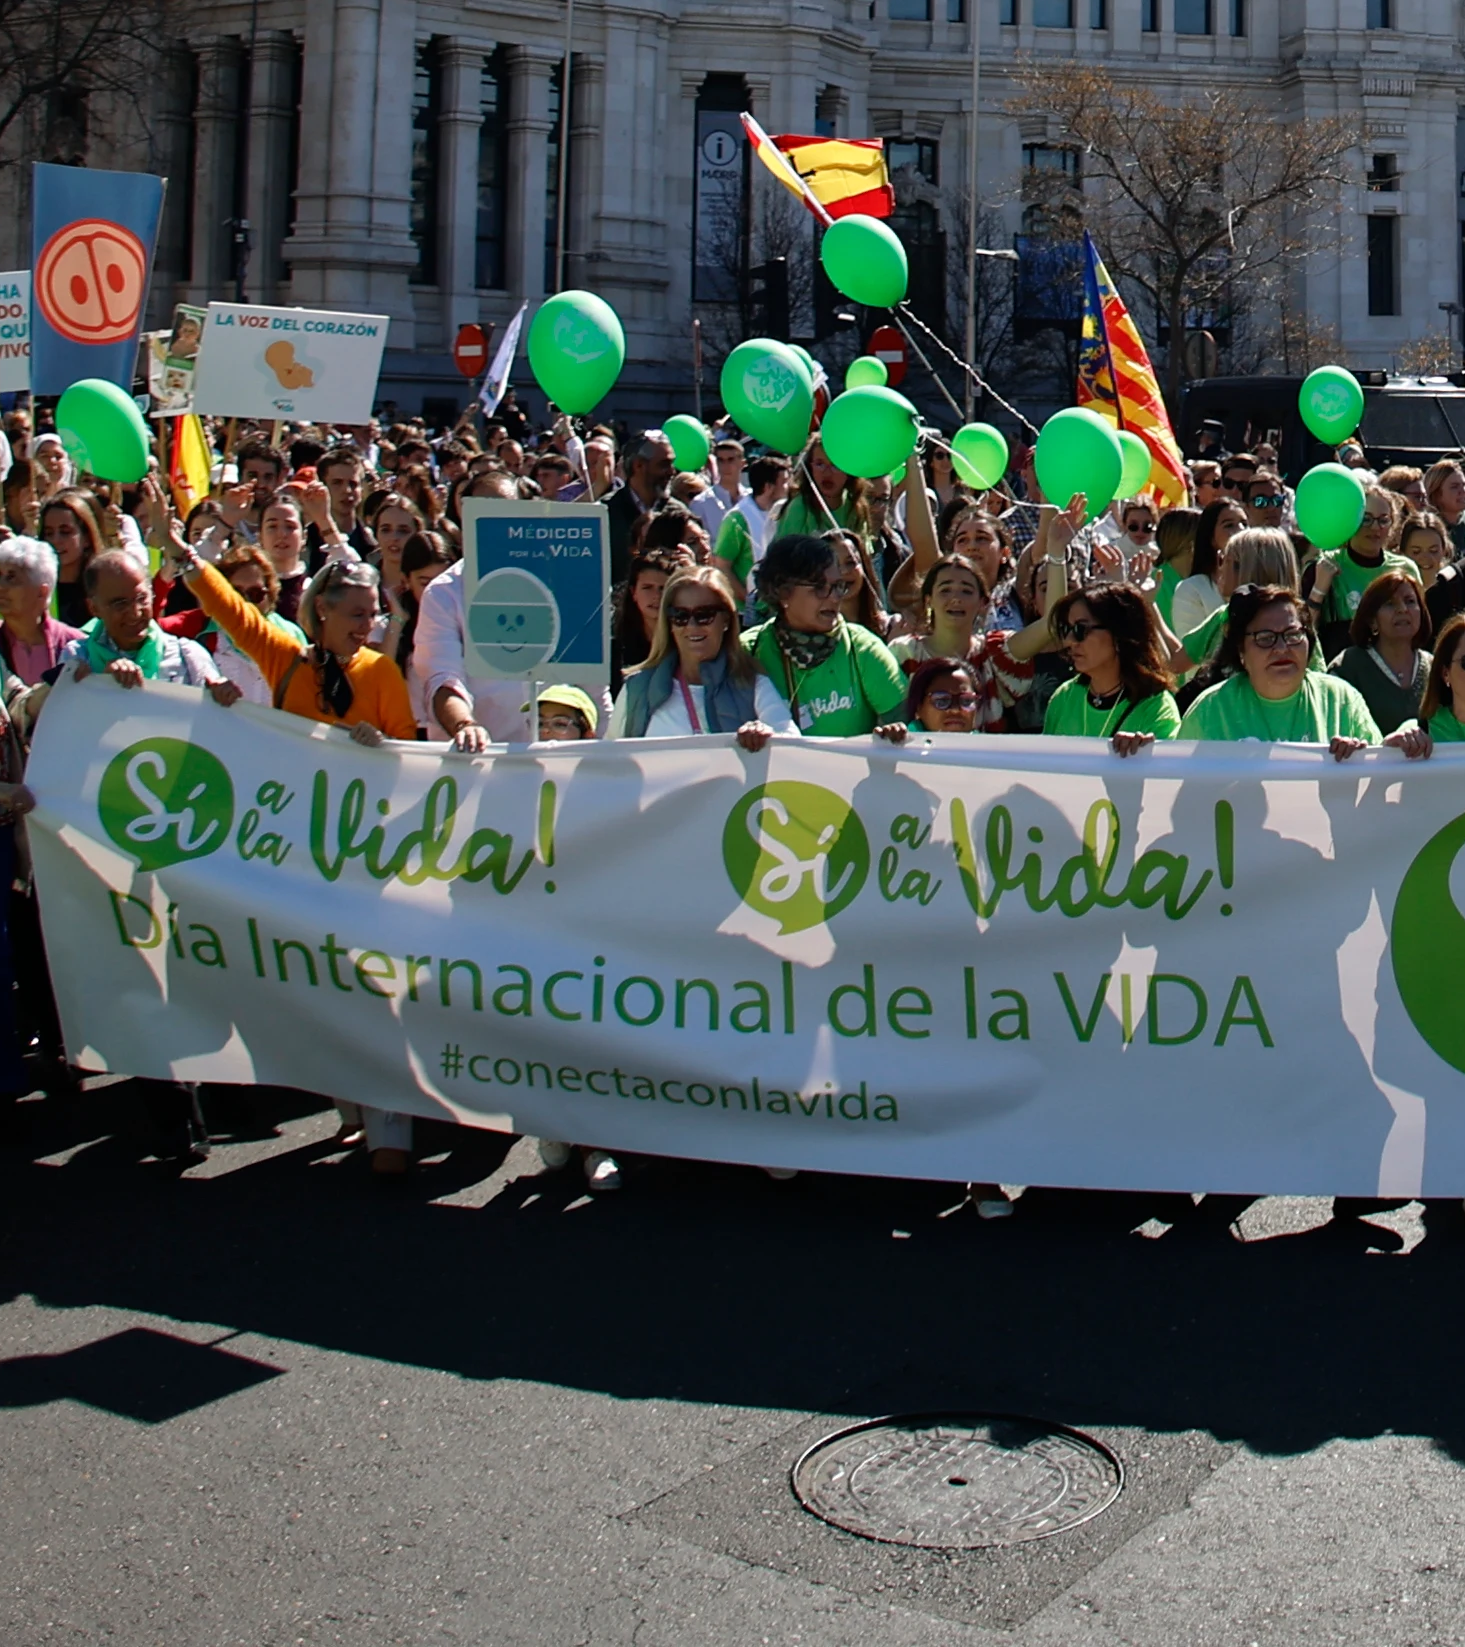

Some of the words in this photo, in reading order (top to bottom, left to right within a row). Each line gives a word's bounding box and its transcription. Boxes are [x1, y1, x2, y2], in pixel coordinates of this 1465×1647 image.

[215, 313, 235, 327] LA
[237, 314, 270, 329] VOZ
[271, 317, 300, 332] DEL
[303, 320, 378, 337] CORAZÓN
[508, 523, 593, 539] MÉDICOS
[549, 544, 593, 558] VIDA
[126, 751, 220, 851] Sí
[257, 780, 295, 815] a
[237, 808, 293, 866] la
[309, 769, 558, 895] Vida!
[746, 796, 857, 904] Sí
[891, 813, 932, 850] a
[878, 846, 942, 906] la
[950, 797, 1234, 920] Vida!
[110, 890, 227, 969] Día
[248, 917, 795, 1035] Internacional
[827, 963, 933, 1040] de
[963, 965, 1031, 1041] la
[1053, 970, 1275, 1048] VIDA
[440, 1043, 899, 1122] #conectaconlavida
